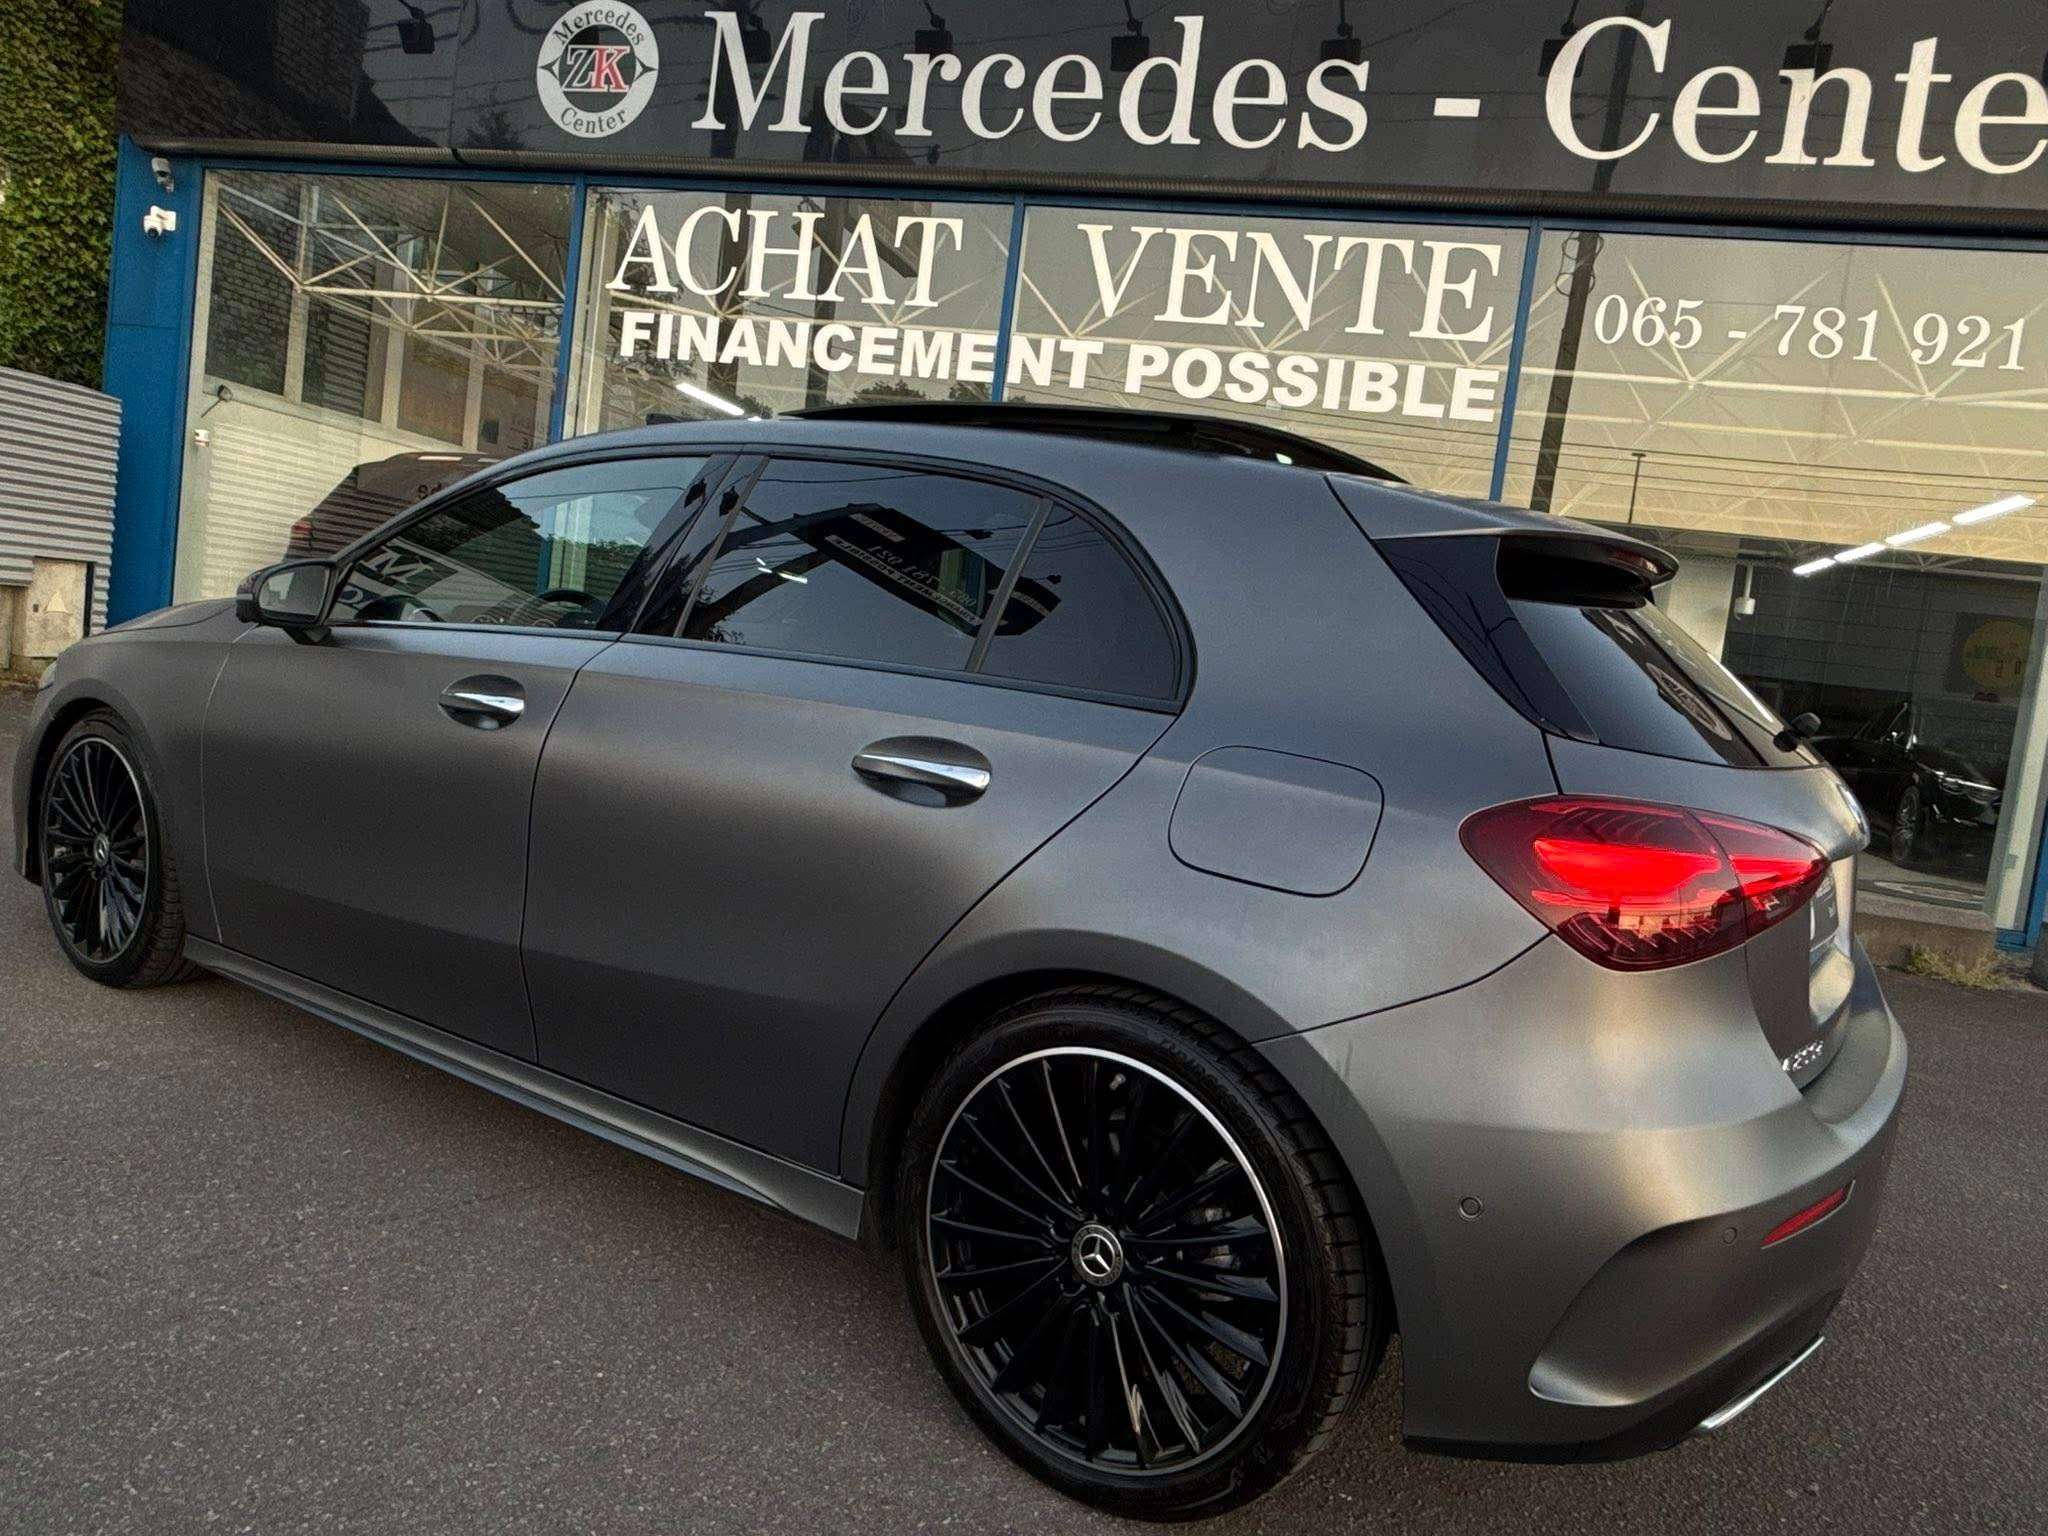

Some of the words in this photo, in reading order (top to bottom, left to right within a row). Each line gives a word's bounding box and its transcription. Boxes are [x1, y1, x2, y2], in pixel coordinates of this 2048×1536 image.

[553, 8, 646, 46] Mercedes
[562, 44, 631, 93] ZK
[691, 10, 1370, 152] Mercedes
[1433, 97, 1481, 118] -
[1545, 15, 2048, 175] Cente
[560, 107, 627, 134] Center
[605, 204, 964, 308] ACHAT
[1077, 222, 1502, 343] VENTE
[619, 311, 1105, 390] FINANCEMENT
[1125, 343, 1500, 423] POSSIBLE
[1593, 294, 1705, 349] 065
[1773, 303, 1880, 362] 781
[1910, 312, 2027, 371] 921
